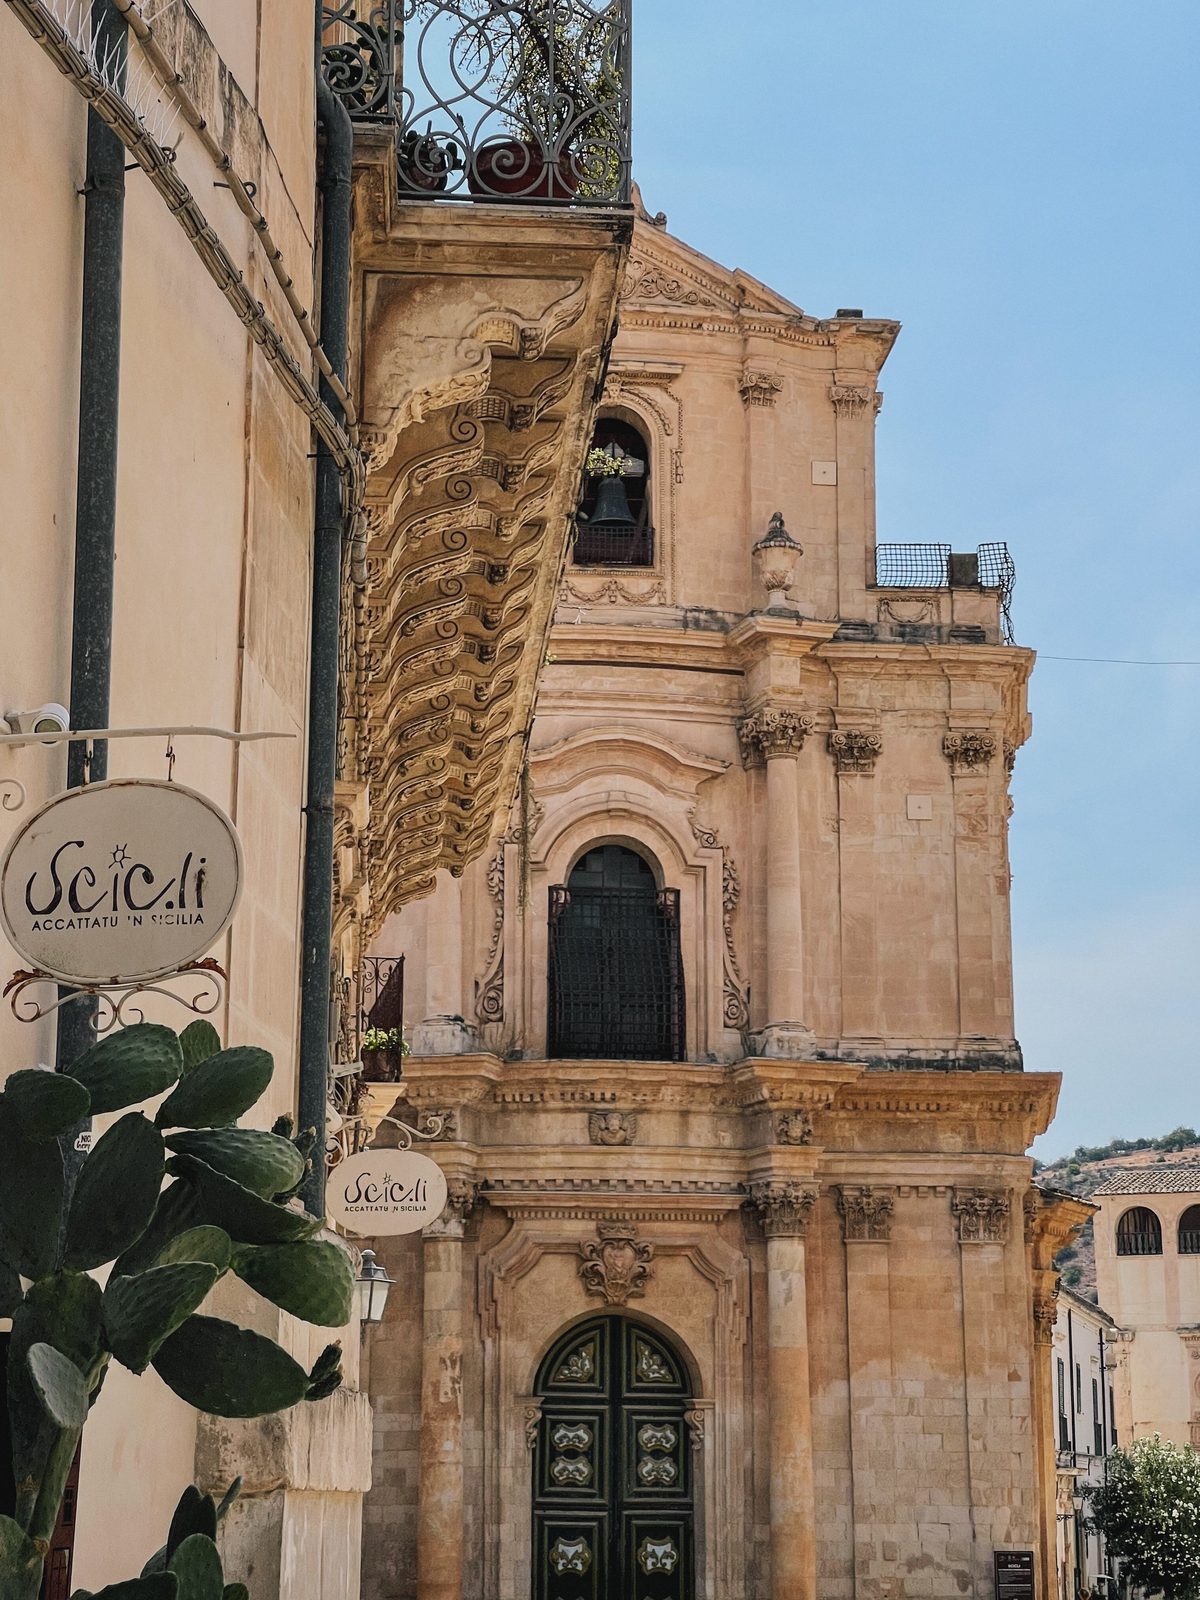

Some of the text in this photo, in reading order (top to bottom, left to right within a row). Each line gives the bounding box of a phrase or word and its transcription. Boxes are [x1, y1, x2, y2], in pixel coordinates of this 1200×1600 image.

[32, 914, 204, 932] ACCATTATU 'N SICILIA
[344, 1205, 389, 1213] ACCATTATU
